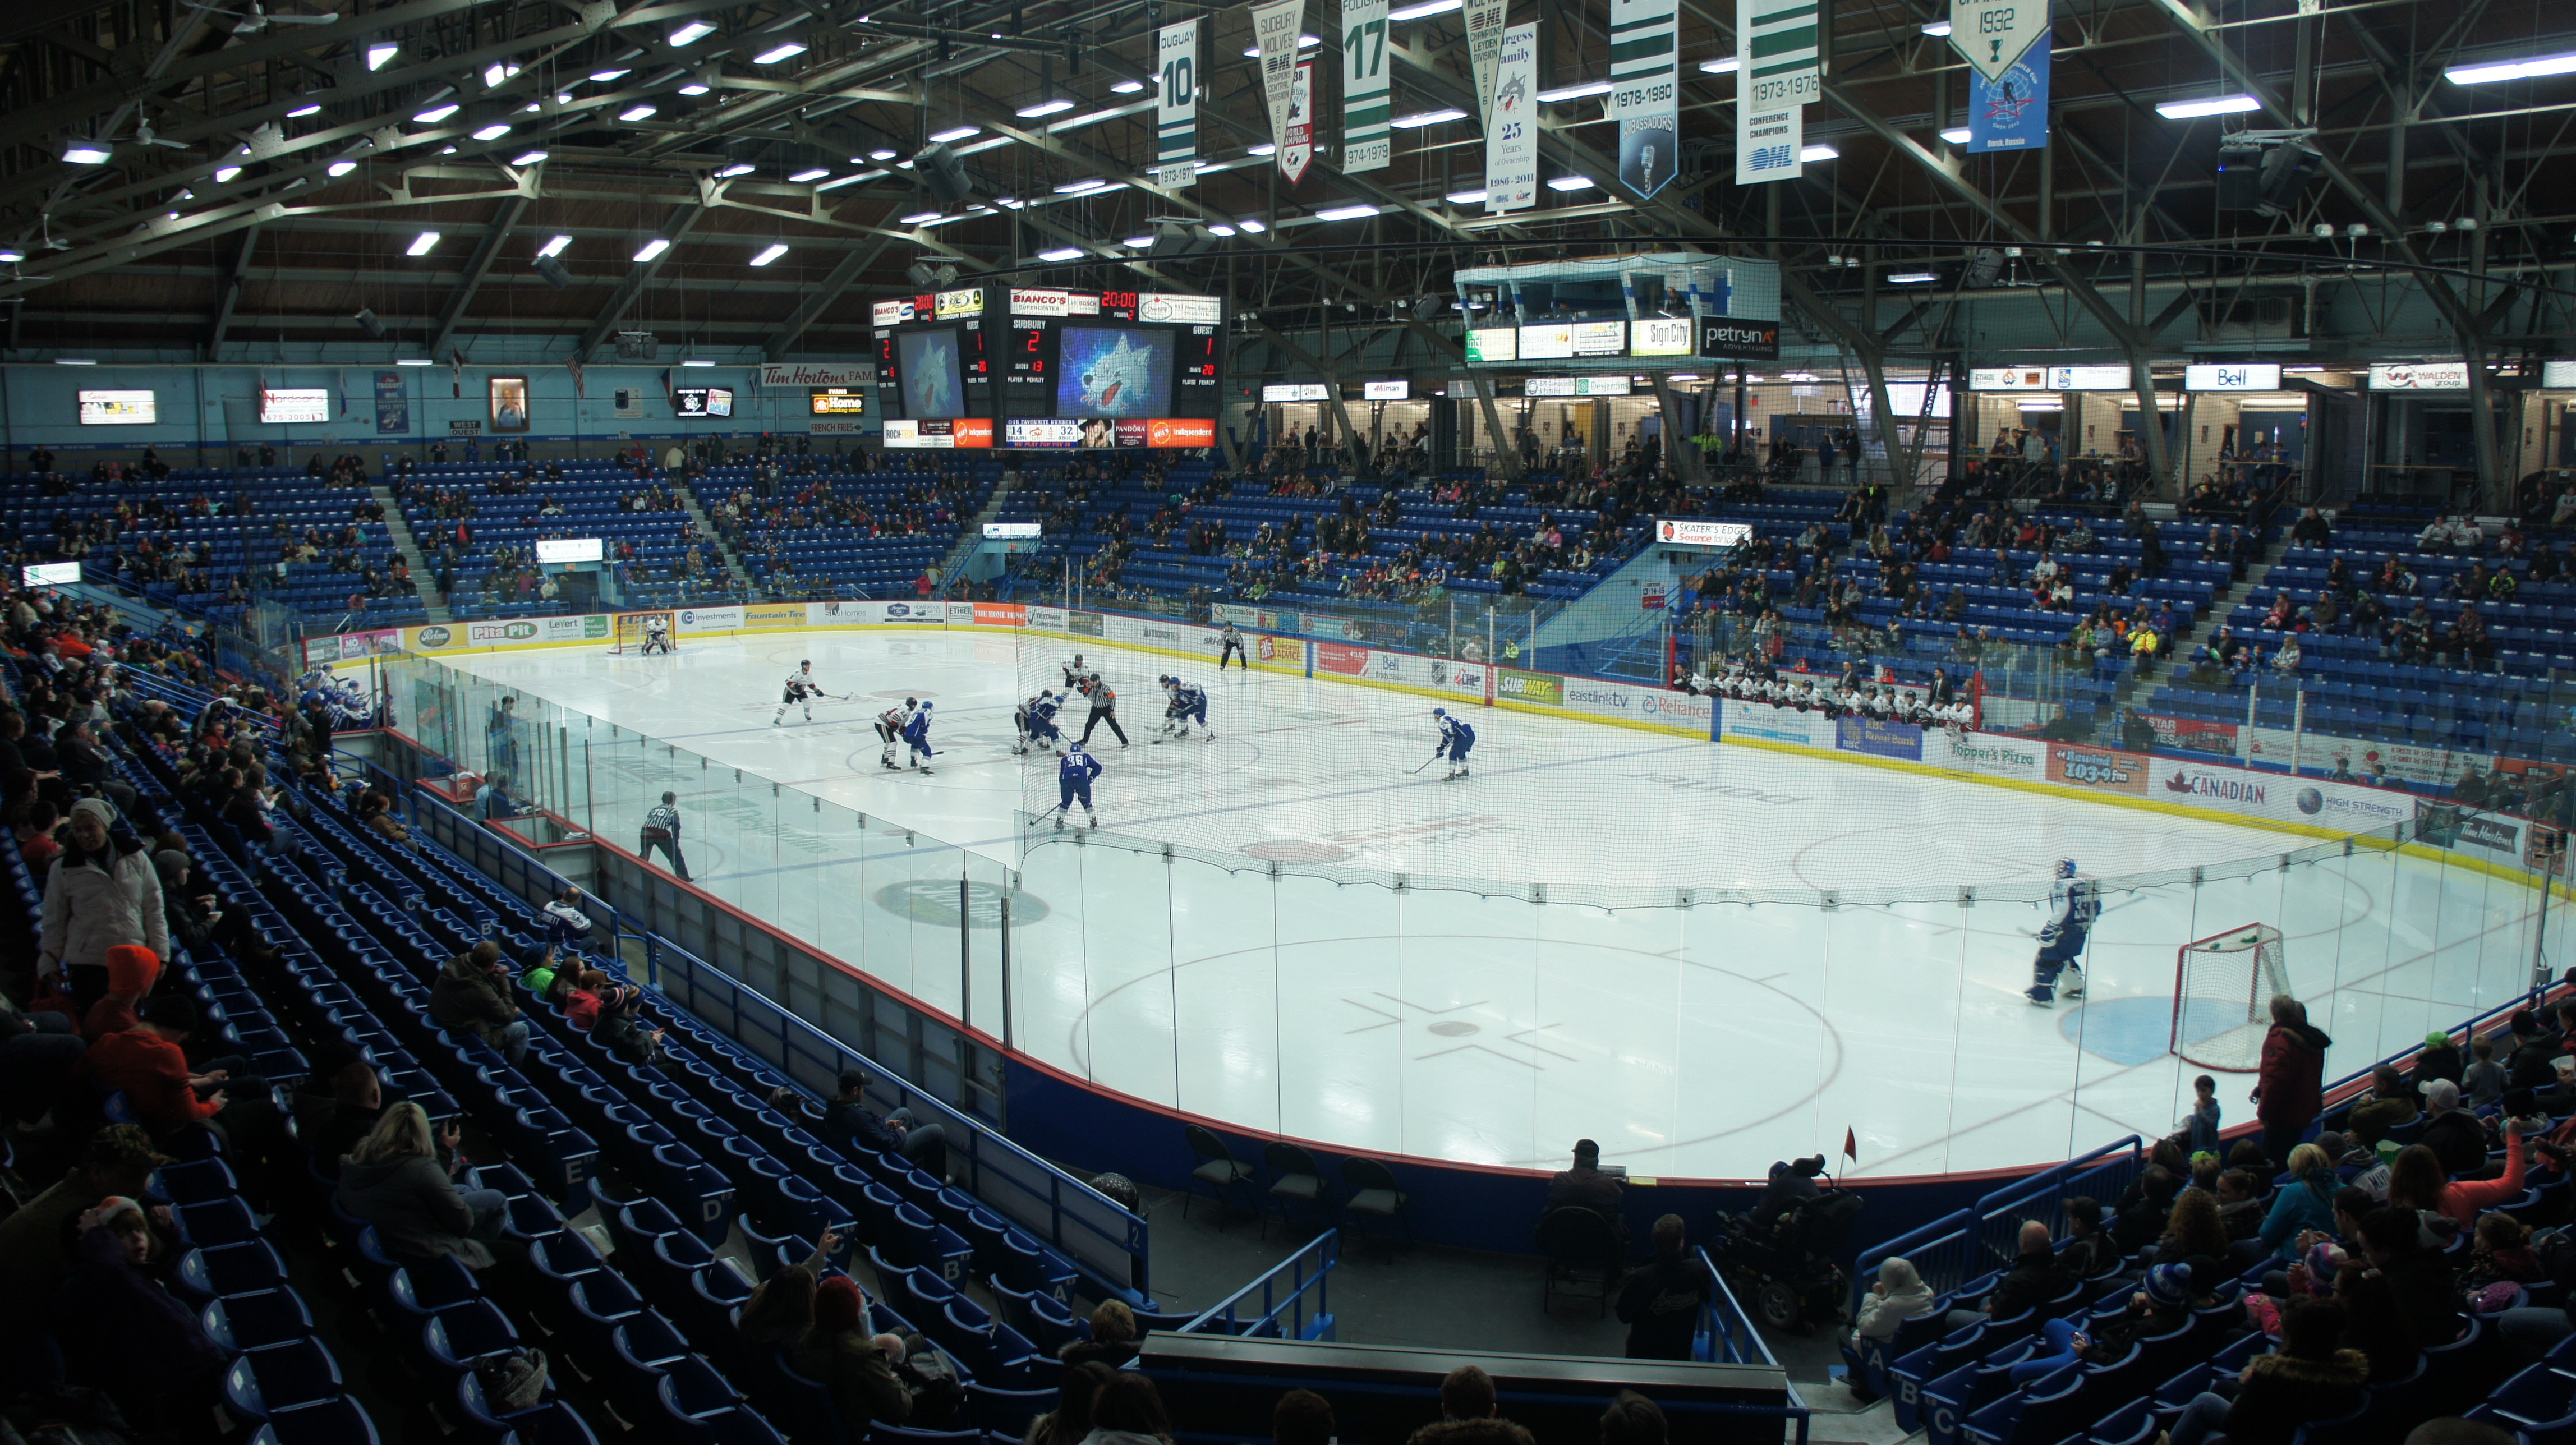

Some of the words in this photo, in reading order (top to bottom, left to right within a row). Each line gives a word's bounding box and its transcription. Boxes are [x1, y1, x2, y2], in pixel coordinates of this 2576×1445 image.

[1261, 10, 1296, 34] SUDBURY
[1979, 8, 2014, 34] 1932
[1161, 30, 1195, 49] DUGUAY
[1470, 26, 1502, 42] CHAMPIONS
[1264, 32, 1293, 54] WOLVES
[1344, 18, 1386, 80] 17
[1474, 38, 1497, 52] LEYDEN
[1474, 49, 1497, 63] DIVISION
[1162, 57, 1192, 109] 10
[1266, 71, 1291, 84] CHAMPIONS
[1268, 82, 1290, 93] CENTRAL
[1752, 74, 1819, 102] 1973-1976
[1268, 91, 1289, 103] DIVISION
[1614, 84, 1672, 108] 1978-1980
[1749, 112, 1789, 126] CONFERENCE
[1501, 122, 1521, 141] 25
[1623, 114, 1673, 140] AMBASSADORS
[1750, 125, 1788, 139] CHAMPIONS
[2004, 137, 2025, 146] Russia
[1344, 144, 1388, 165] 1974-1979
[1501, 145, 1522, 155] Years
[1501, 156, 1530, 165] Ownership
[1745, 145, 1793, 172] OHL
[1161, 167, 1195, 183] 1973-1977
[1490, 177, 1510, 188] 1986
[1515, 173, 1534, 185] 2011
[915, 294, 933, 311] 20:00
[1013, 295, 1066, 305] BIANCO'S
[1101, 292, 1137, 307] 20:00
[875, 306, 899, 316] BIANCO'S
[928, 311, 933, 322] 2
[936, 312, 959, 321] ALGONQUIN
[1128, 310, 1134, 321] 2
[967, 320, 979, 330] GUEST
[1013, 320, 1046, 330] SUDBURY
[1193, 326, 1213, 335] GUEST
[978, 332, 983, 351] 1
[1027, 331, 1039, 352] 2
[1650, 324, 1669, 346] Sign
[1671, 323, 1688, 345] City
[1706, 327, 1762, 348] petryn
[884, 339, 891, 359] 2
[1207, 338, 1212, 356] 1
[1722, 343, 1773, 352] ADVERTISING
[1033, 360, 1043, 372] 13
[1202, 364, 1214, 375] 20
[764, 366, 789, 384] Tim
[792, 366, 845, 384] Hortons
[2218, 369, 2246, 385] Bell
[2418, 372, 2461, 380] WALDEN
[1591, 381, 1629, 392] Desjardins
[829, 397, 862, 408] Home
[811, 424, 835, 432] FRENCH
[968, 428, 992, 438] Independent
[1011, 426, 1022, 435] 14
[1061, 426, 1073, 435] 32
[1679, 523, 1718, 534] SKATER'S
[1722, 525, 1746, 536] EDGE
[1678, 533, 1712, 542] Source
[696, 613, 737, 621] Investments
[746, 611, 786, 619] Fountain
[949, 606, 972, 615] ETHIER
[1037, 613, 1061, 621] TESTMARK
[421, 628, 448, 641] Perkins
[473, 627, 505, 639] Pita
[508, 624, 531, 637] Pit
[345, 639, 359, 648] NO
[1277, 649, 1301, 661] ADVICE
[1382, 655, 1400, 670] Bell
[1375, 671, 1393, 679] Brady
[1499, 676, 1553, 697] SUBWAY
[1569, 690, 1629, 708] eastlinktv
[1659, 697, 1710, 719] Reliance
[1738, 712, 1778, 725] BrokerLink
[1866, 719, 1886, 731] RBC
[2148, 717, 2176, 729] STAR
[1843, 740, 1860, 749] RBC
[1865, 730, 1890, 744] Royal
[1892, 734, 1916, 747] Bank
[1949, 741, 1999, 761] Topper's
[2000, 749, 2035, 767] Pizza
[2066, 749, 2112, 767] Rewind
[1068, 755, 1083, 768] 36
[2111, 770, 2130, 783] fm
[2191, 776, 2265, 804] CANADIAN
[2326, 797, 2349, 808] HIGH
[2352, 801, 2403, 817] STRENGTH
[2461, 821, 2478, 839] Tim
[2478, 825, 2513, 847] Hortons
[481, 923, 493, 936] B
[565, 1161, 585, 1184] E
[703, 1199, 723, 1223] D
[944, 1260, 961, 1281] B
[1052, 1285, 1068, 1303] A
[1868, 1349, 1884, 1370] A
[1900, 1380, 1917, 1405] B
[1934, 1407, 1954, 1435] C
